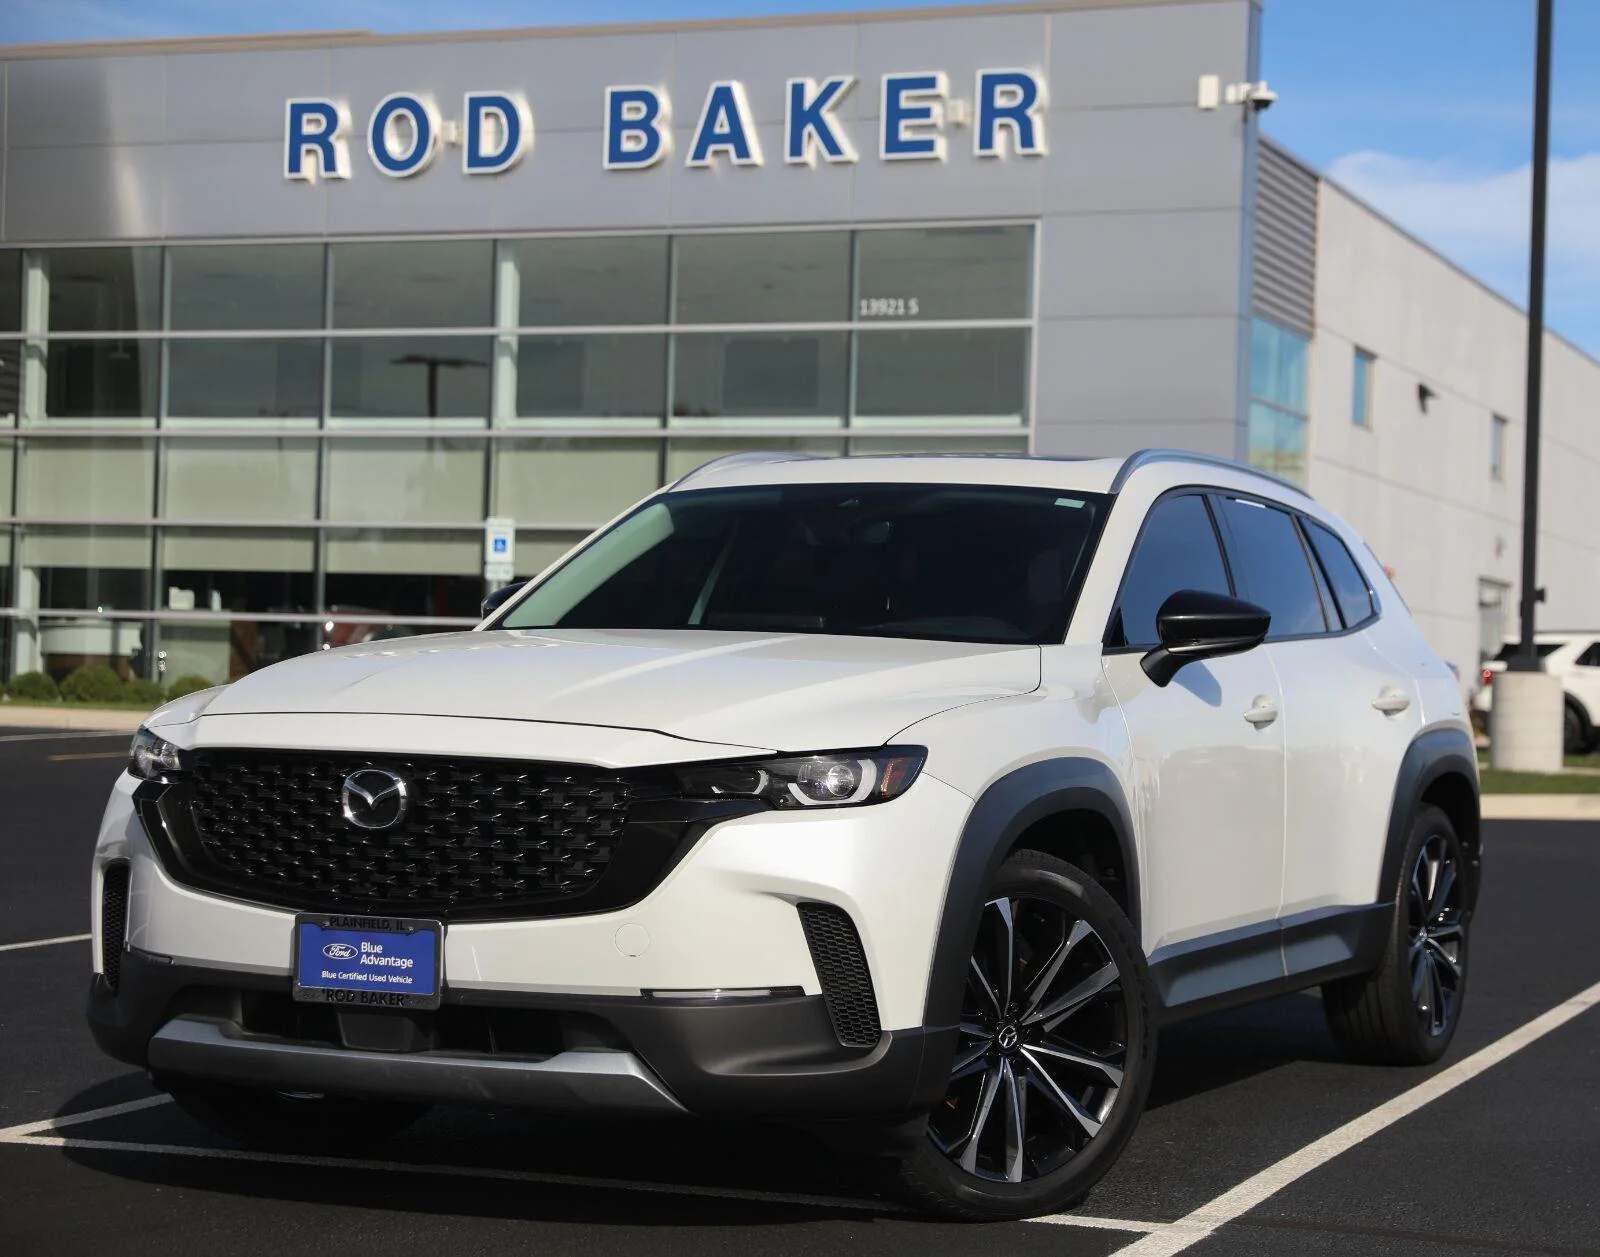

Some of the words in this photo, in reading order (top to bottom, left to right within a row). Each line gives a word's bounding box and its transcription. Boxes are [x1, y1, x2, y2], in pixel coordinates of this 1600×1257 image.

[284, 91, 531, 182] ROD
[603, 68, 1048, 170] BAKER
[329, 916, 392, 931] PLAINFIELD,
[396, 922, 405, 931] IL
[329, 946, 351, 958] Ford
[361, 942, 383, 953] Blue
[360, 955, 413, 969] Advantage
[322, 970, 337, 979] Blue
[338, 971, 367, 981] Certified
[369, 974, 387, 982] Used
[389, 975, 413, 984] Vehicle
